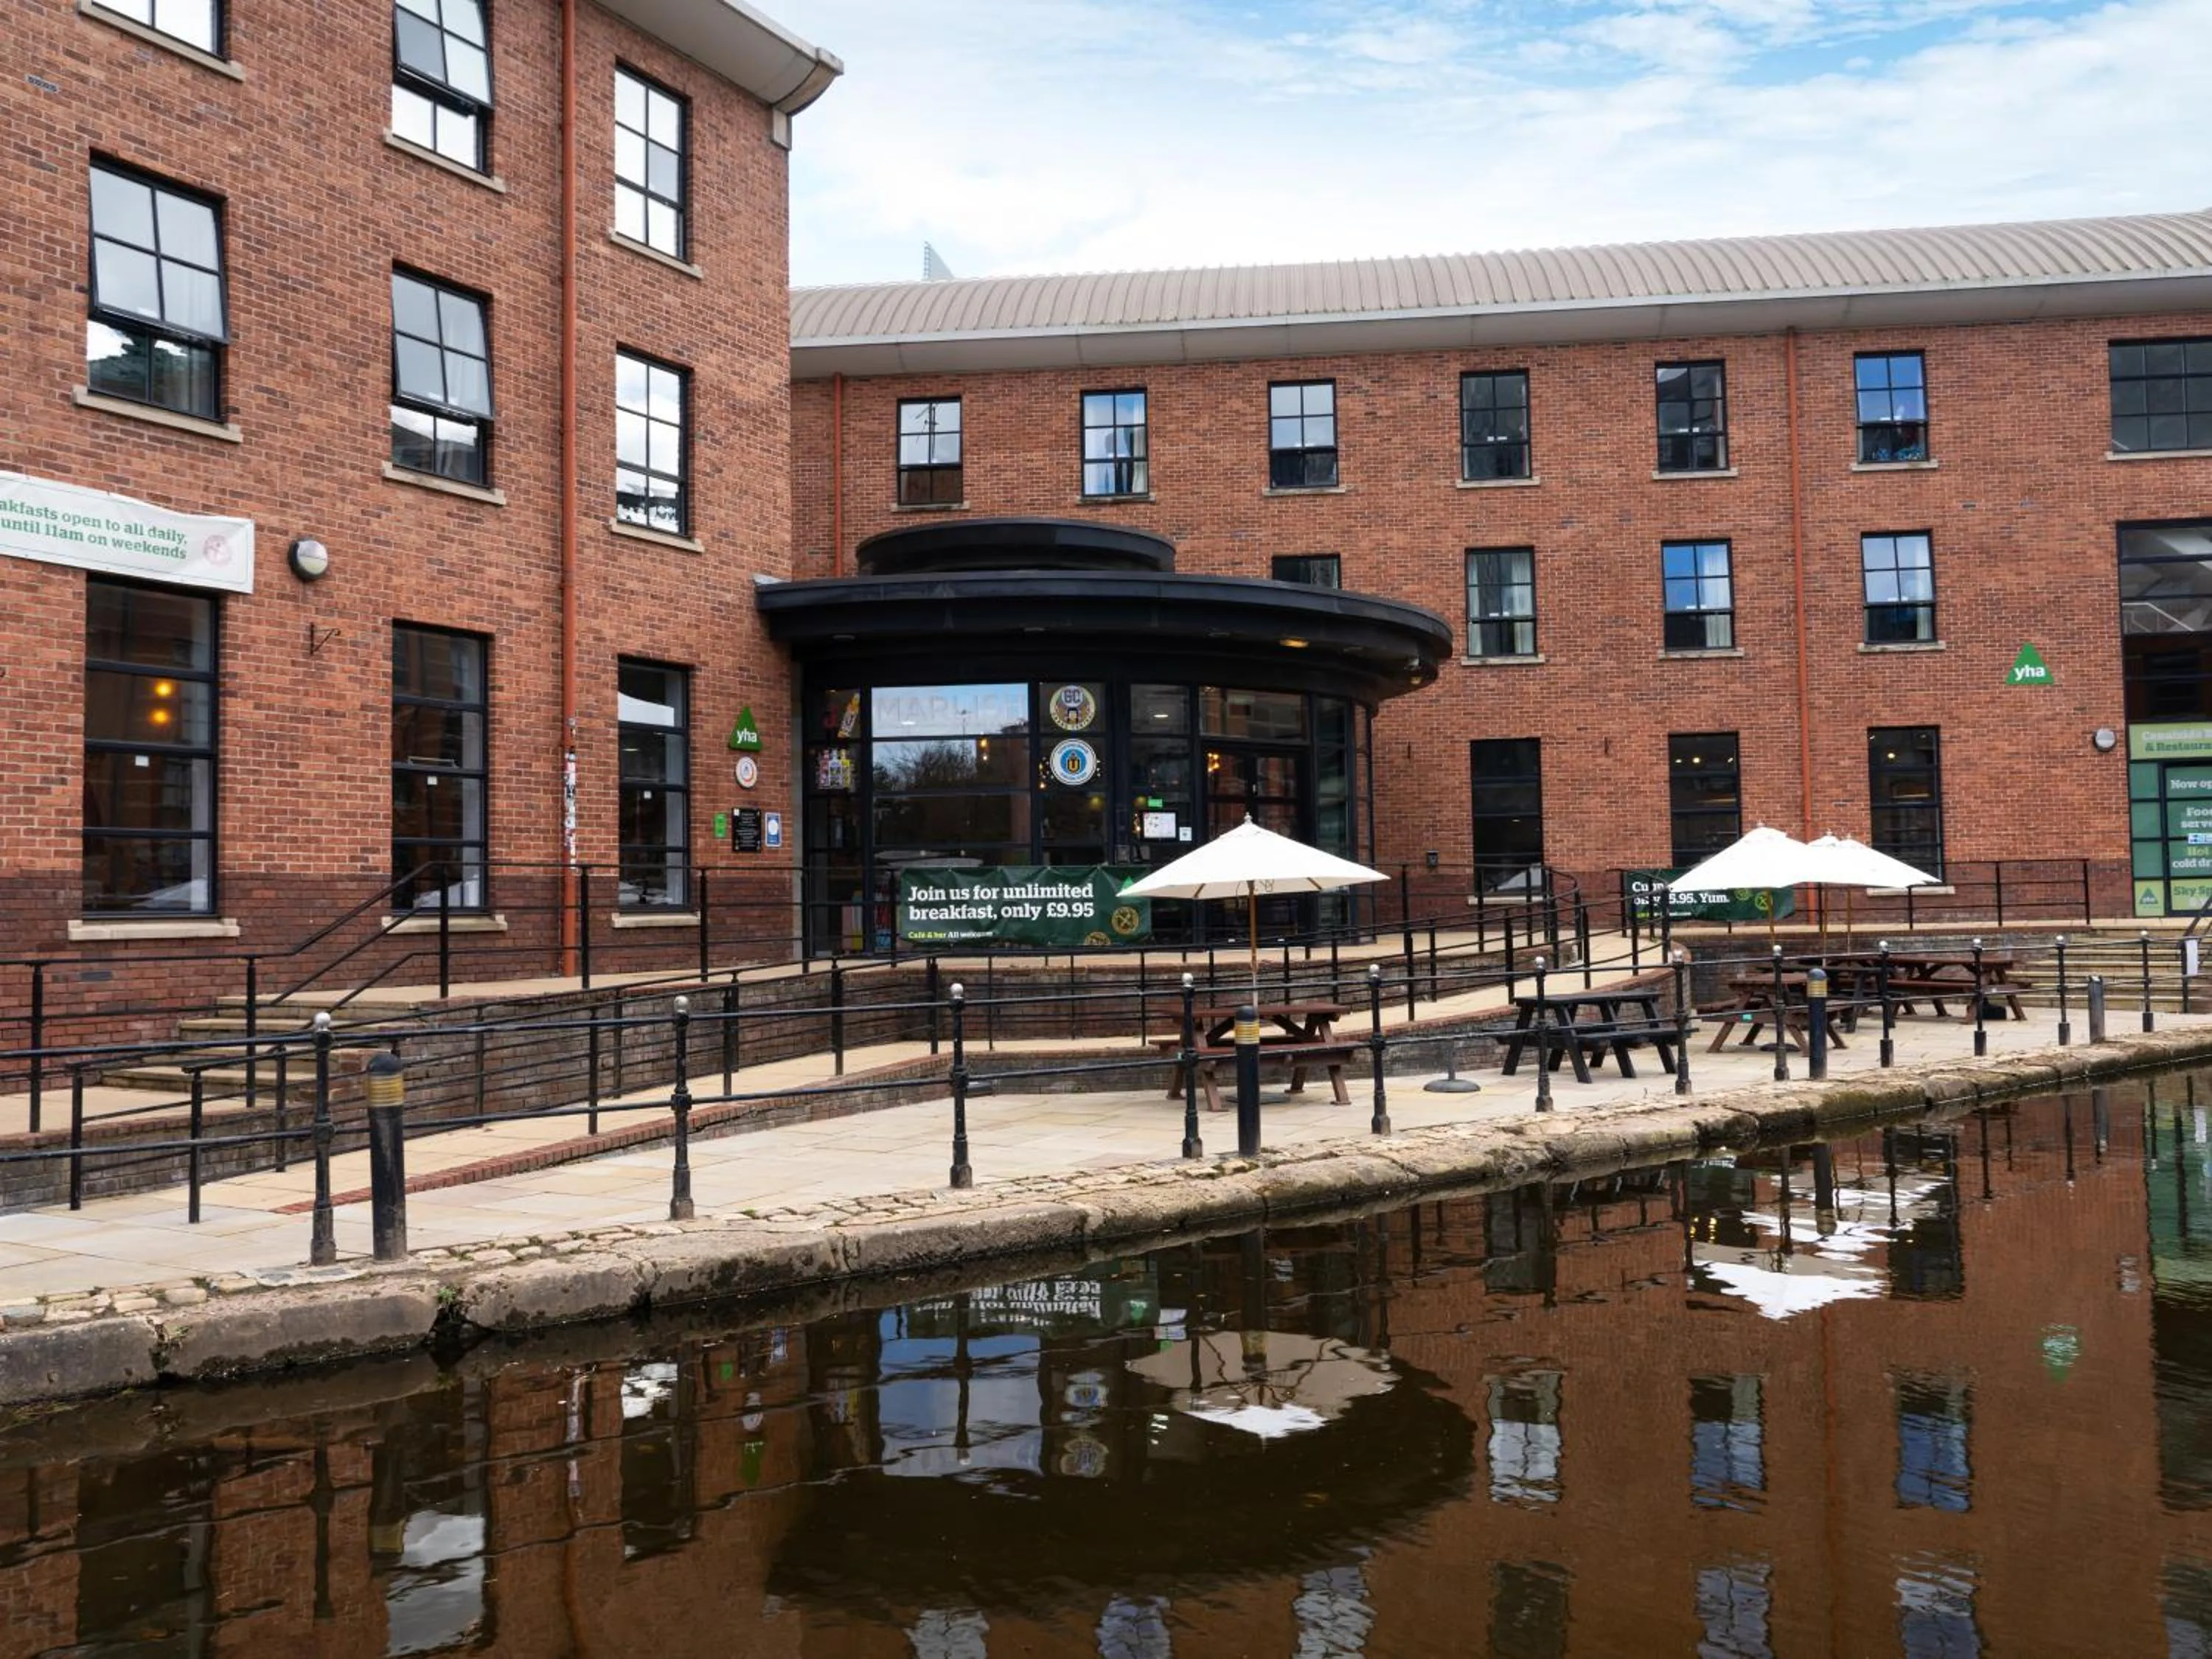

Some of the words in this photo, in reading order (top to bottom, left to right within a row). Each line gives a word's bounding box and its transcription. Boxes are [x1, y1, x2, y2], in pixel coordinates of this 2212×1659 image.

[62, 512, 101, 529] open
[106, 518, 121, 532] to
[124, 523, 144, 536] all
[1, 518, 40, 535] until
[45, 524, 83, 541] 11am
[88, 532, 107, 546] on
[112, 537, 187, 559] weekends
[2014, 664, 2045, 681] yha
[737, 728, 758, 744] yha
[2171, 779, 2197, 789] Now
[2172, 859, 2197, 868] cold
[908, 886, 946, 901] Join
[950, 888, 970, 900] us
[973, 885, 1000, 900] for
[1003, 883, 1094, 899] unlimited
[1699, 892, 1730, 903] Yum.
[909, 903, 998, 920] breakfast,
[1001, 903, 1042, 920] only
[1046, 902, 1095, 918] £9.95
